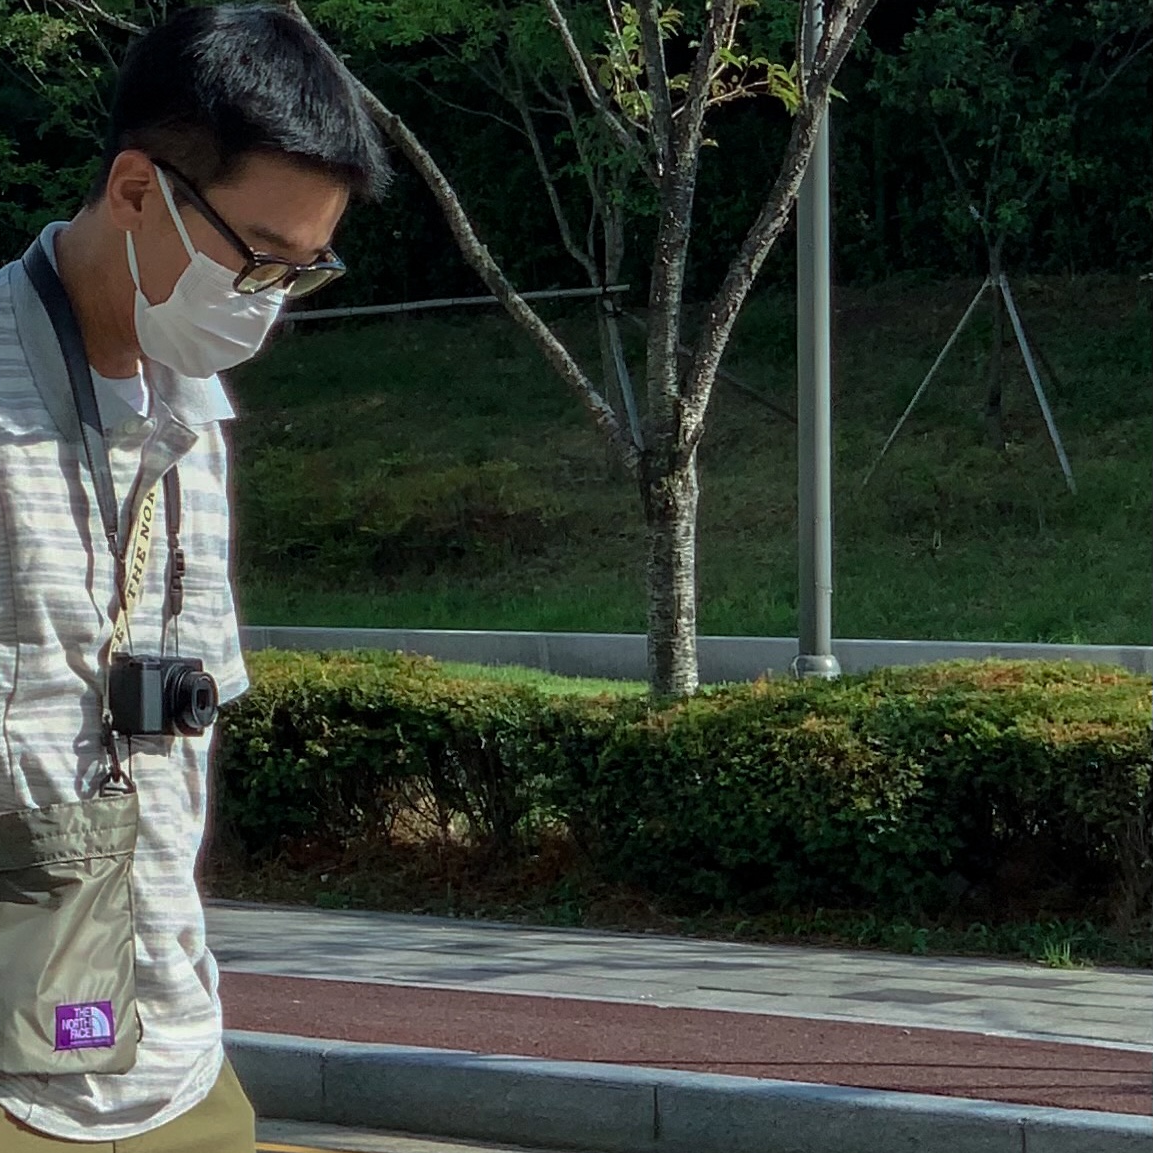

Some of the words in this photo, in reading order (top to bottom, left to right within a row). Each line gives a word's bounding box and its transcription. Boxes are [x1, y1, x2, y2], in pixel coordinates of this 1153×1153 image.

[127, 547, 146, 600] THE
[74, 1006, 92, 1018] THE
[61, 1018, 92, 1031] NORTH
[70, 1028, 92, 1040] FACE
